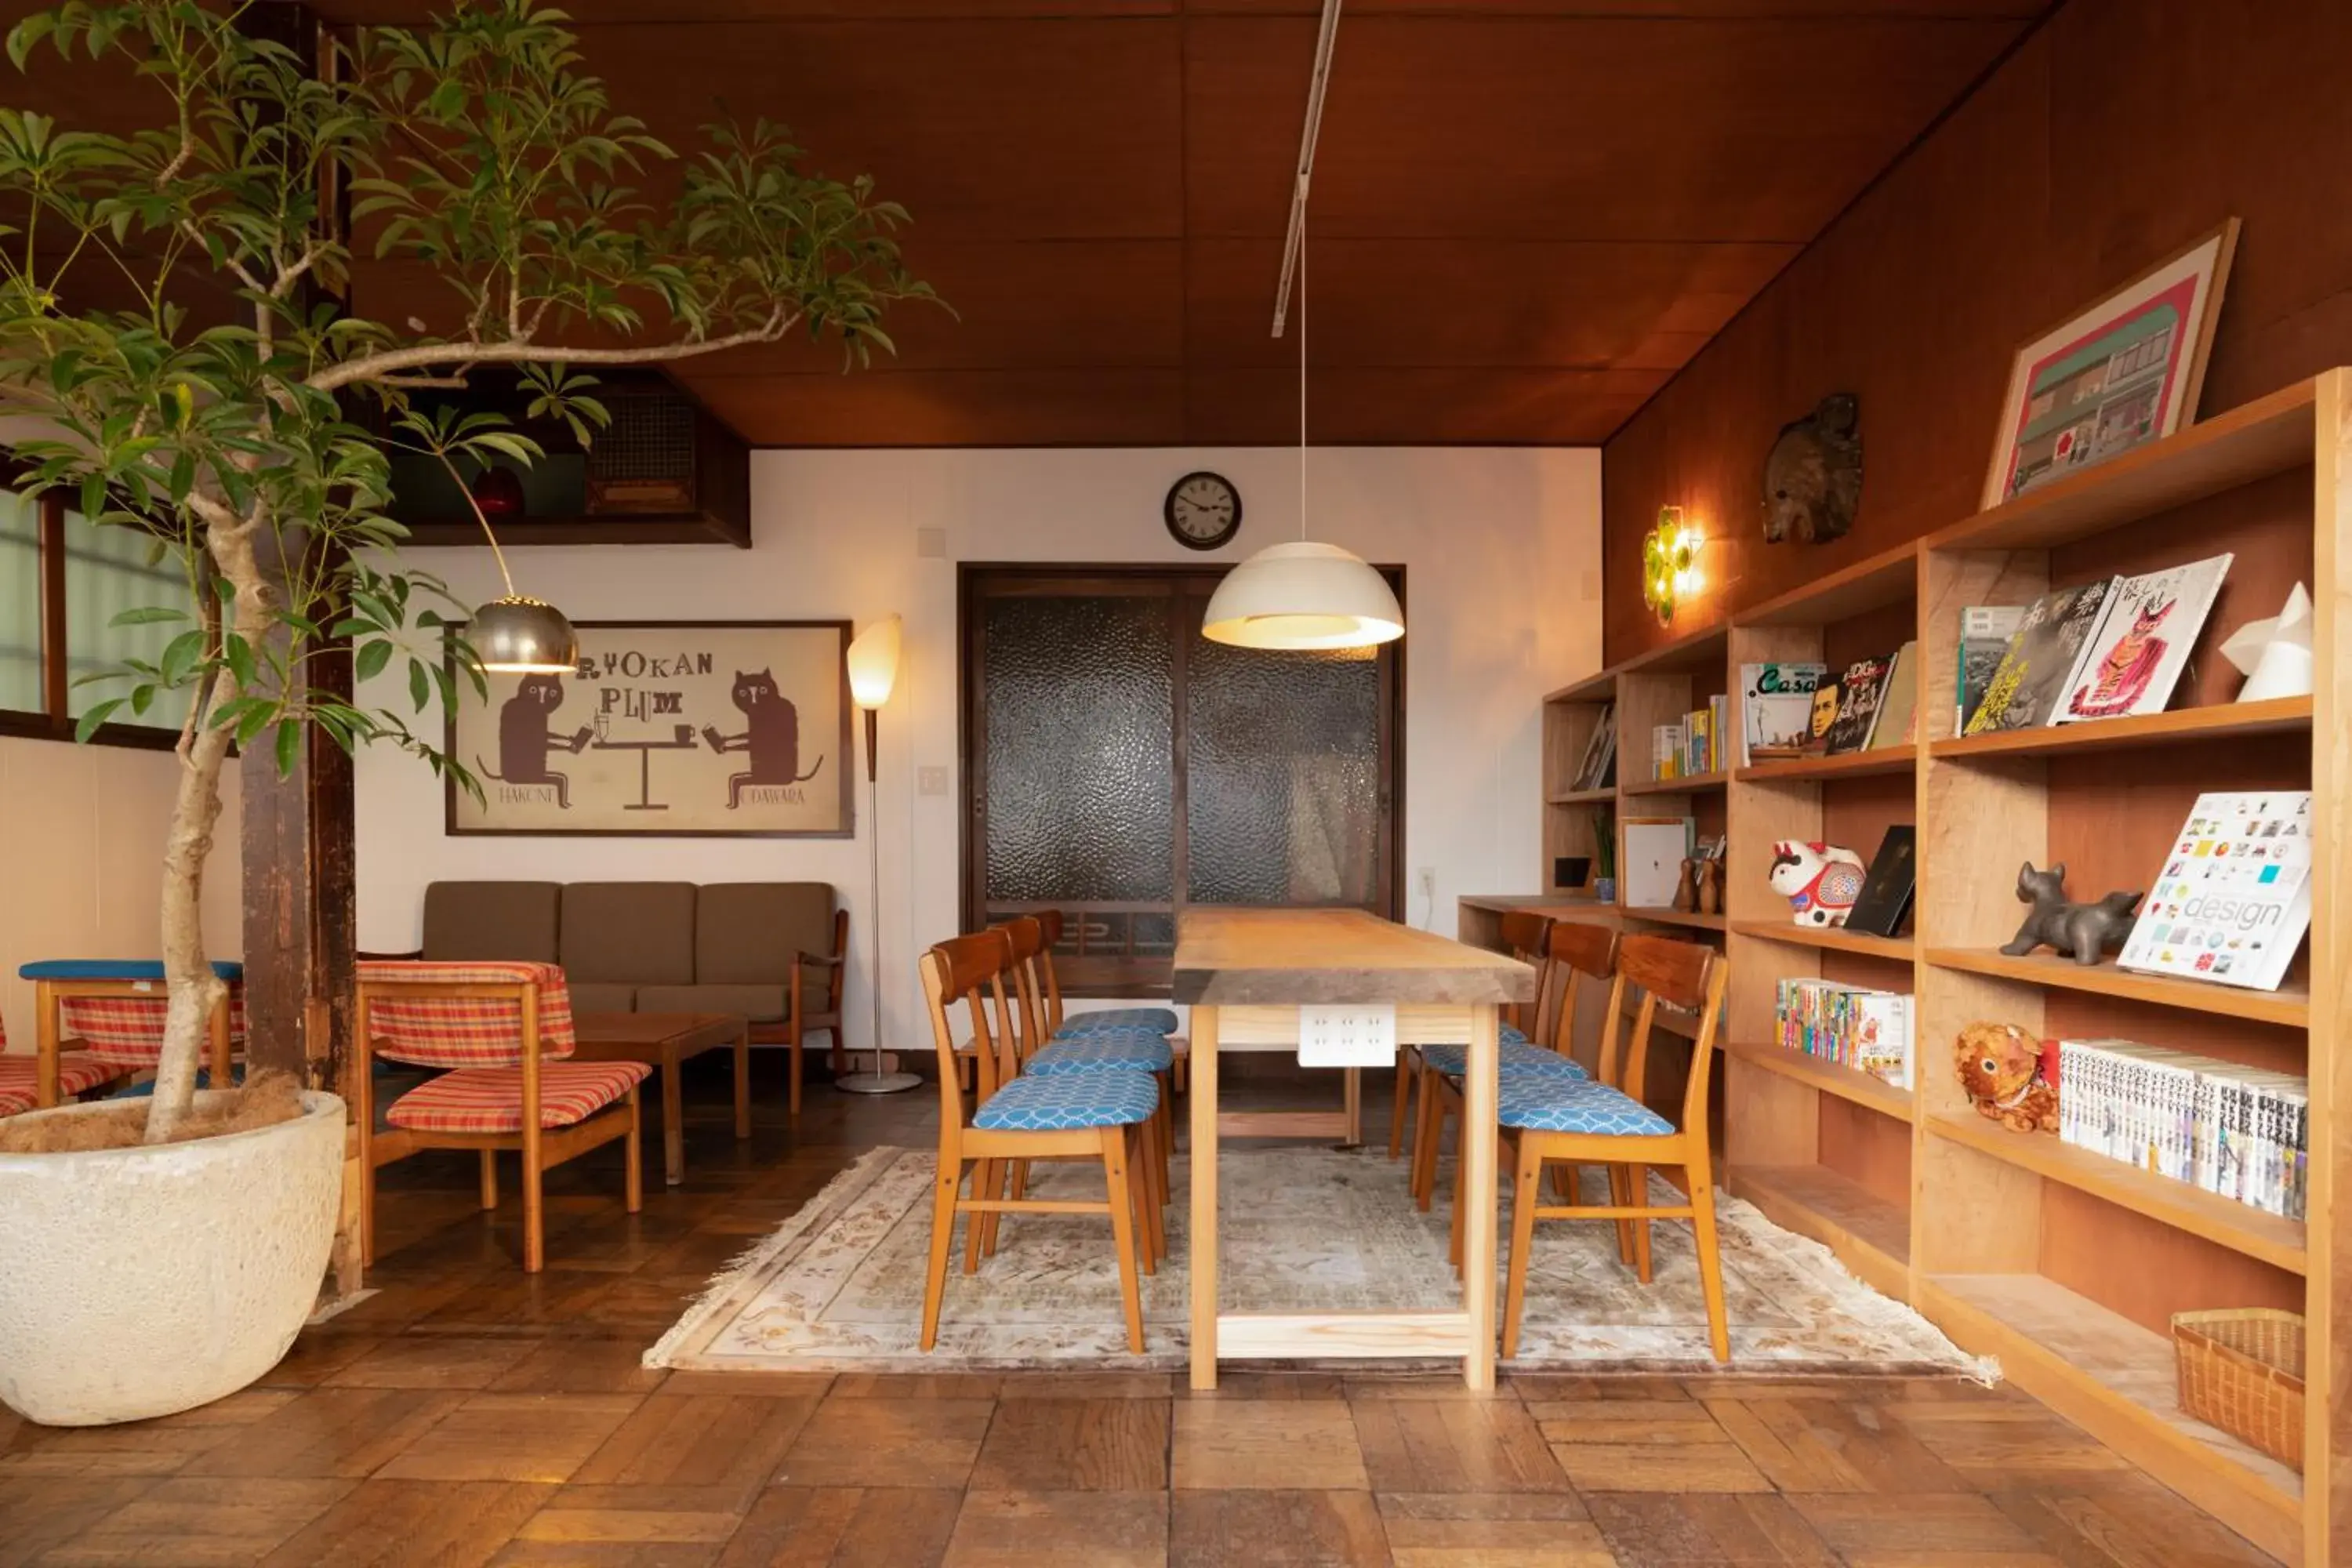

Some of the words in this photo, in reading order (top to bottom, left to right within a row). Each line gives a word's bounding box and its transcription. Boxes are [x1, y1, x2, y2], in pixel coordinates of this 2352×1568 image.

[575, 651, 713, 680] RYOKAN
[1756, 668, 1817, 695] Casa
[600, 687, 683, 723] PLUM
[2183, 891, 2282, 931] design
